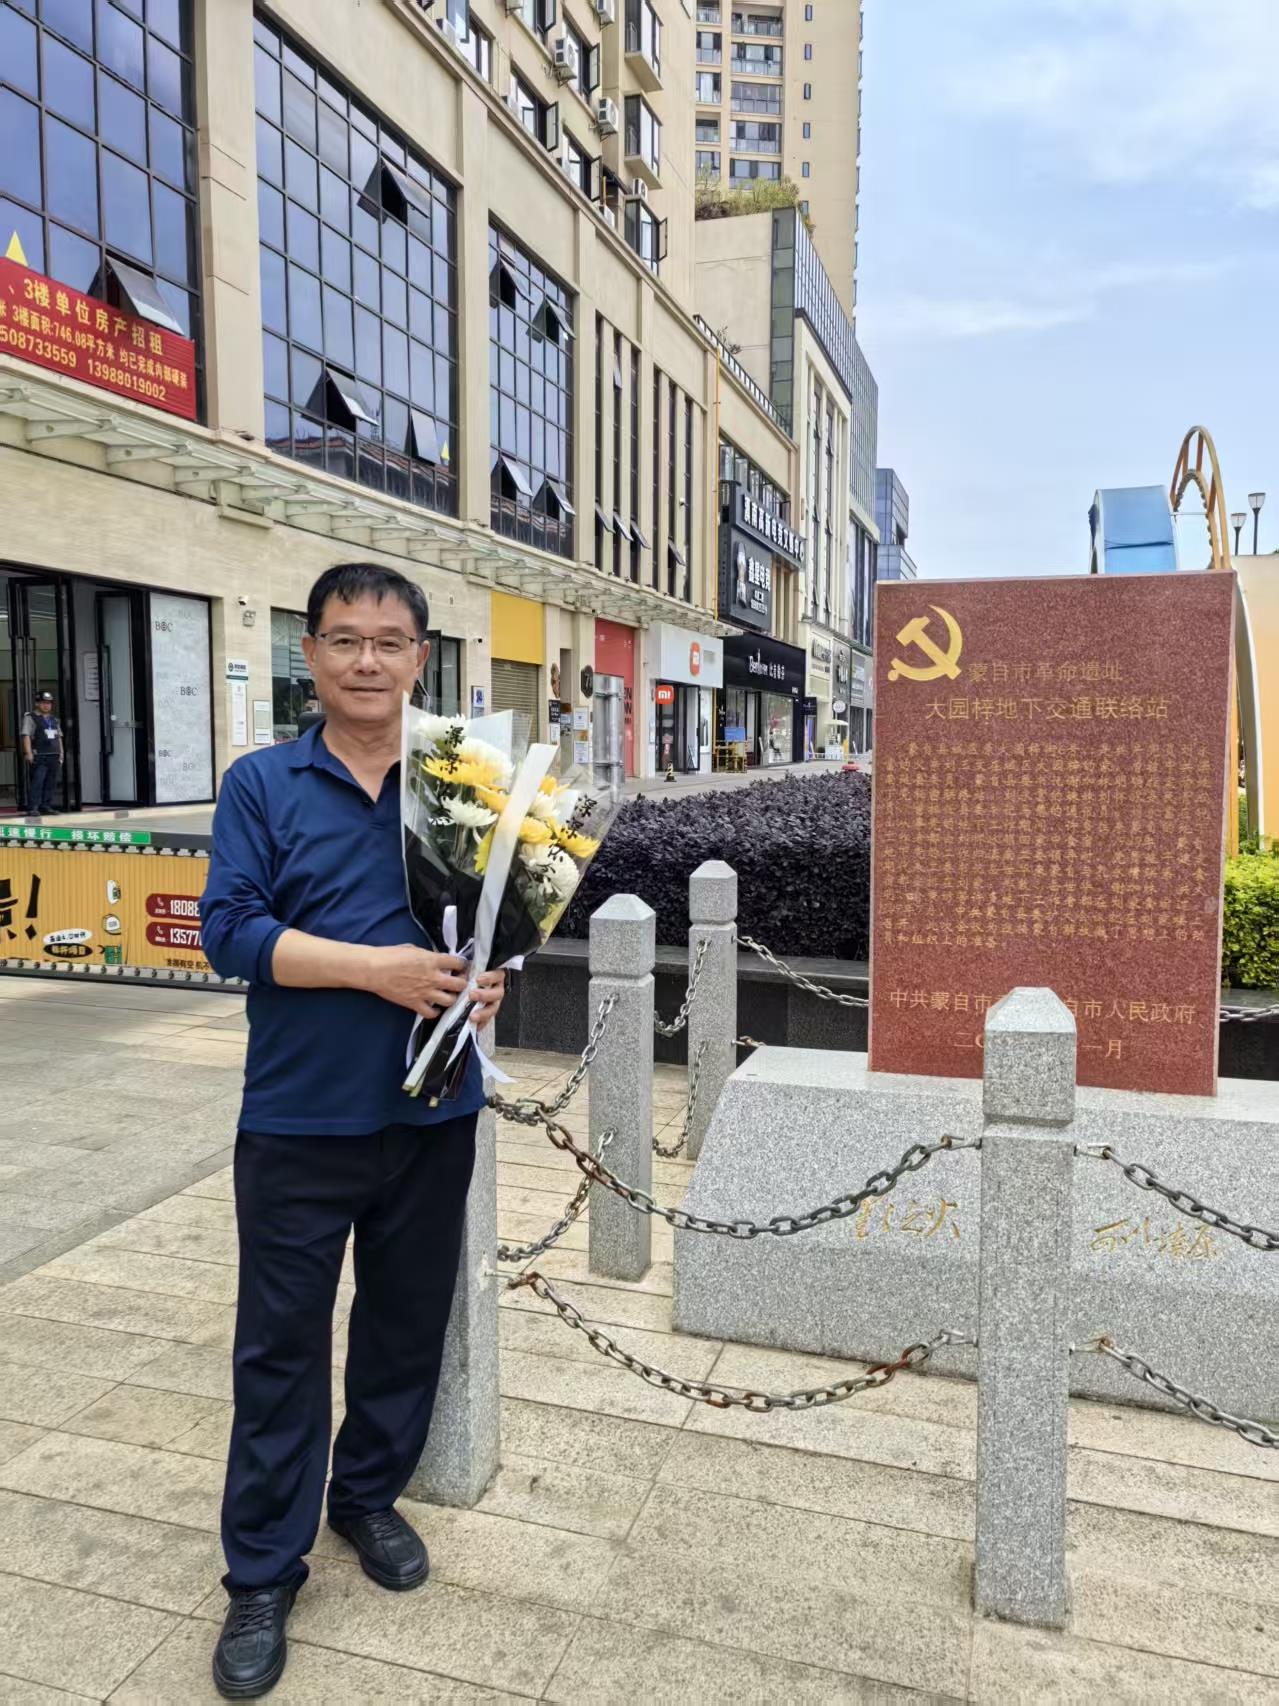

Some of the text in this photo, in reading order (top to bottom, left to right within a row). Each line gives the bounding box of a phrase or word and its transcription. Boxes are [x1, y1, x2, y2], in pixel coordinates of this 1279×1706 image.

[87, 359, 167, 402] 13988019002
[967, 661, 1124, 683] 蒙自市革命遗址
[0, 825, 53, 840] 速慢行
